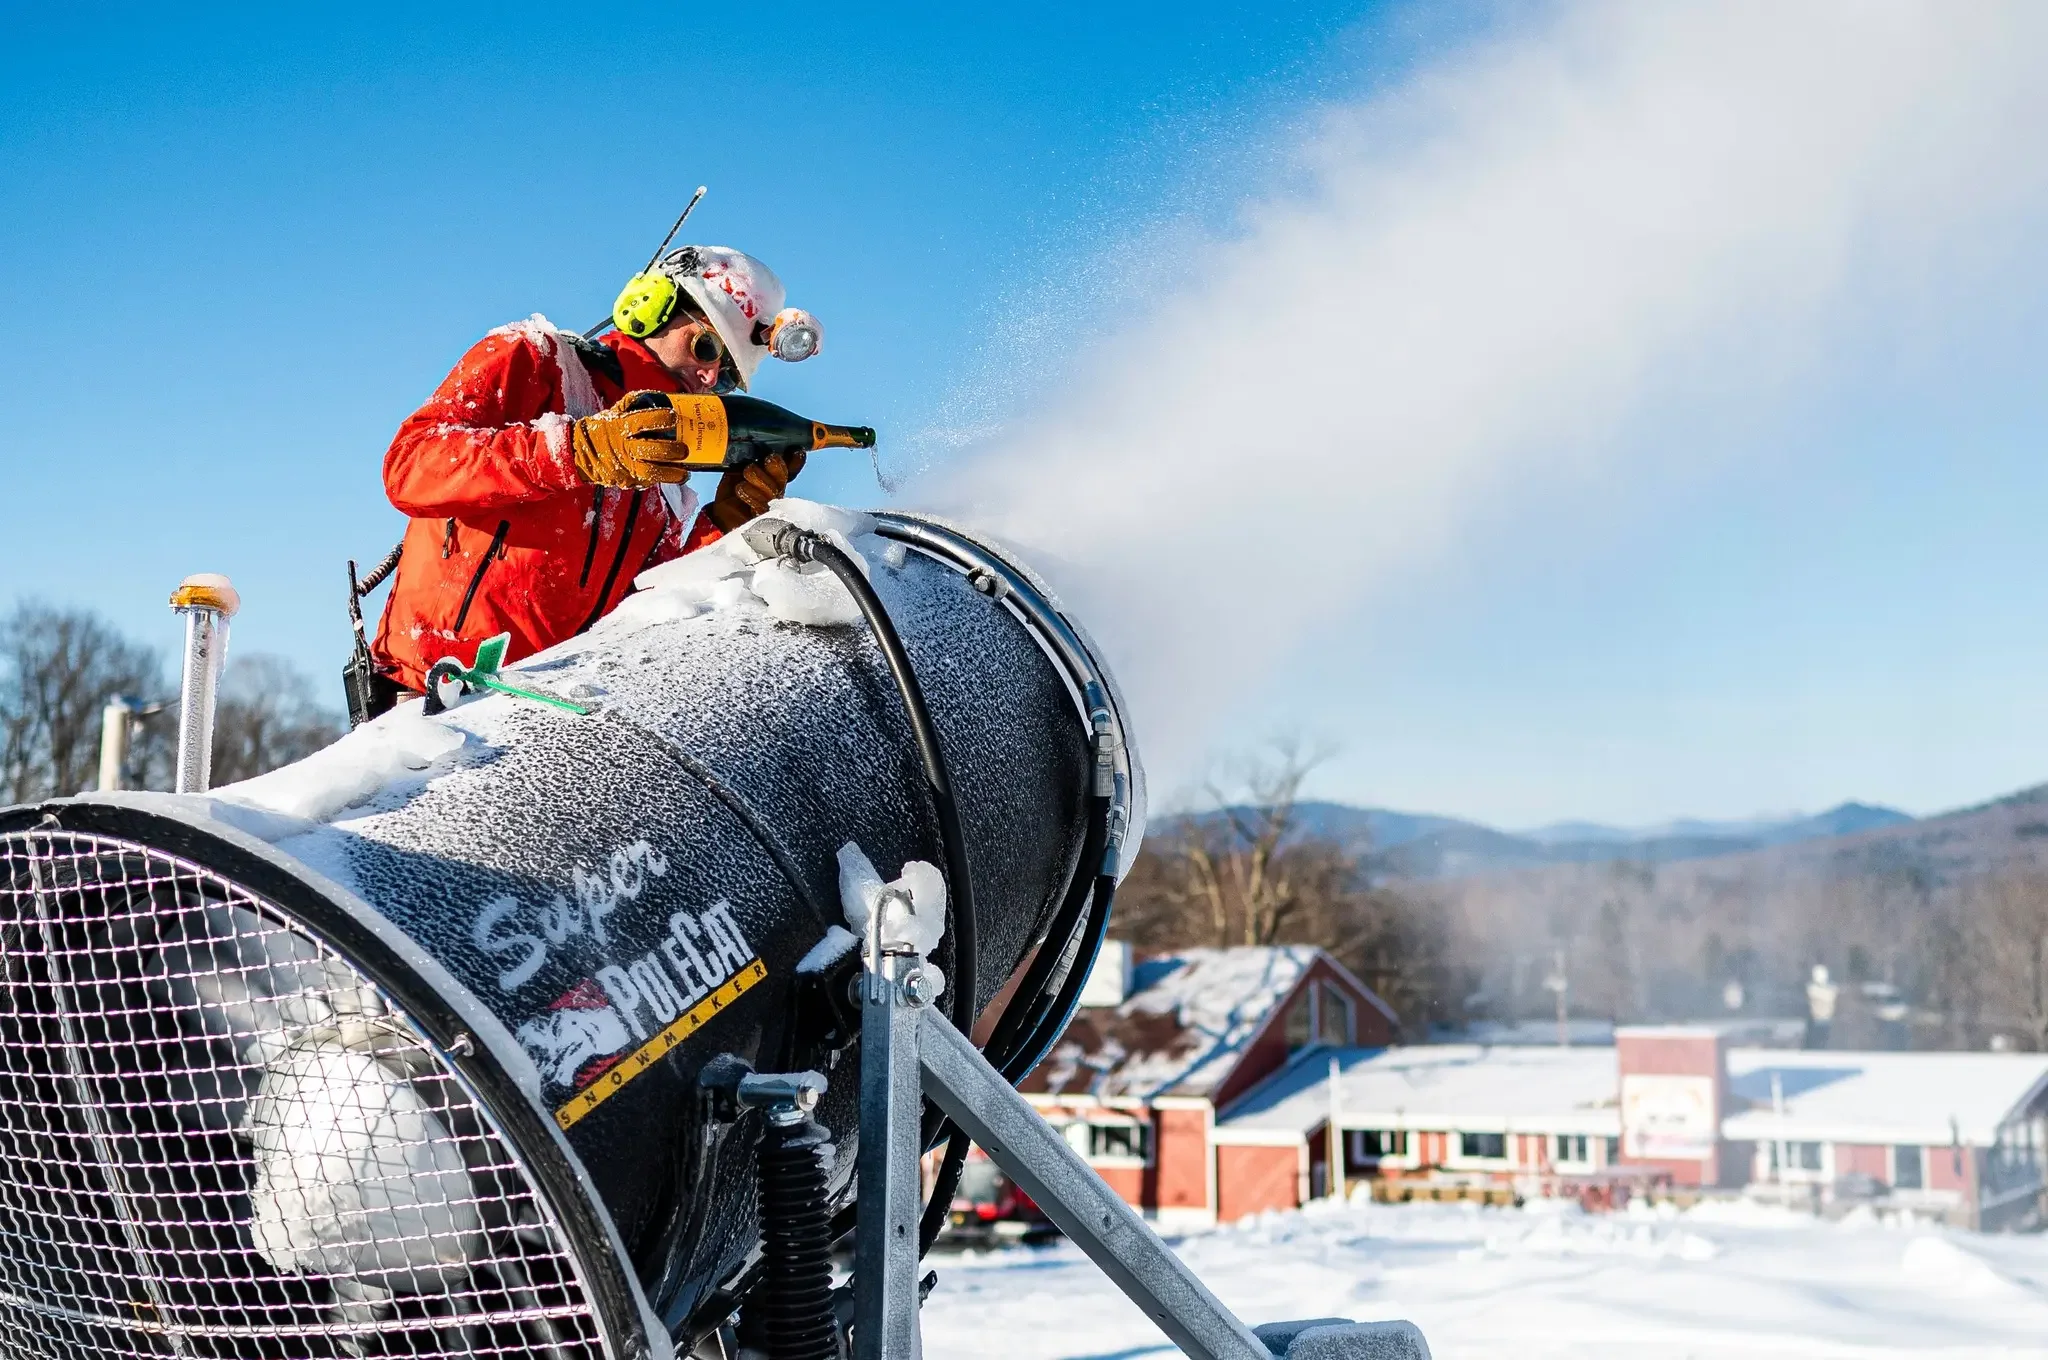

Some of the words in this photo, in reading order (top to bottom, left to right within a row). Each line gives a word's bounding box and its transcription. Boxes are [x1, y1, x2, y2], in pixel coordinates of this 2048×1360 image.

[696, 421, 706, 451] Clicquot
[472, 839, 670, 990] Super
[560, 964, 765, 1127] SNOWMAKER
